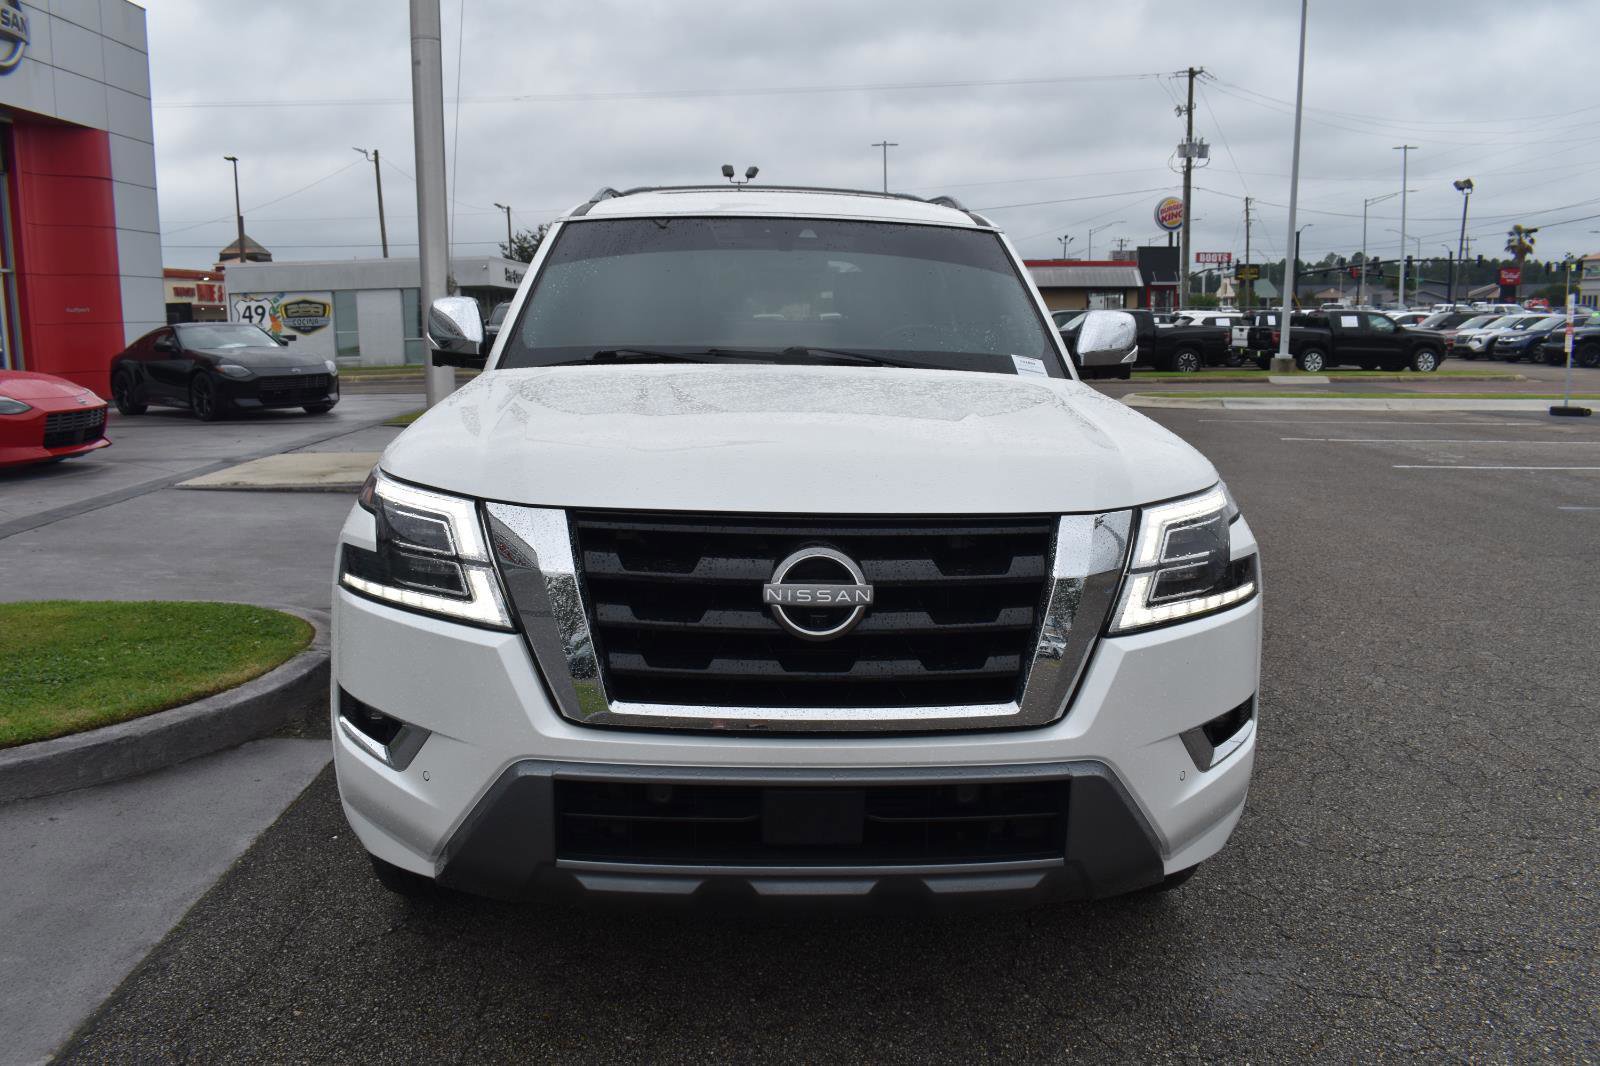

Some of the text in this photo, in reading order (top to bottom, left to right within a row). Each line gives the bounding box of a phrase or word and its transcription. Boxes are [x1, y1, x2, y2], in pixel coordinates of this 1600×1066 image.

[1199, 253, 1230, 263] BOOTS
[242, 305, 266, 323] 49
[767, 589, 871, 602] NISSAN
